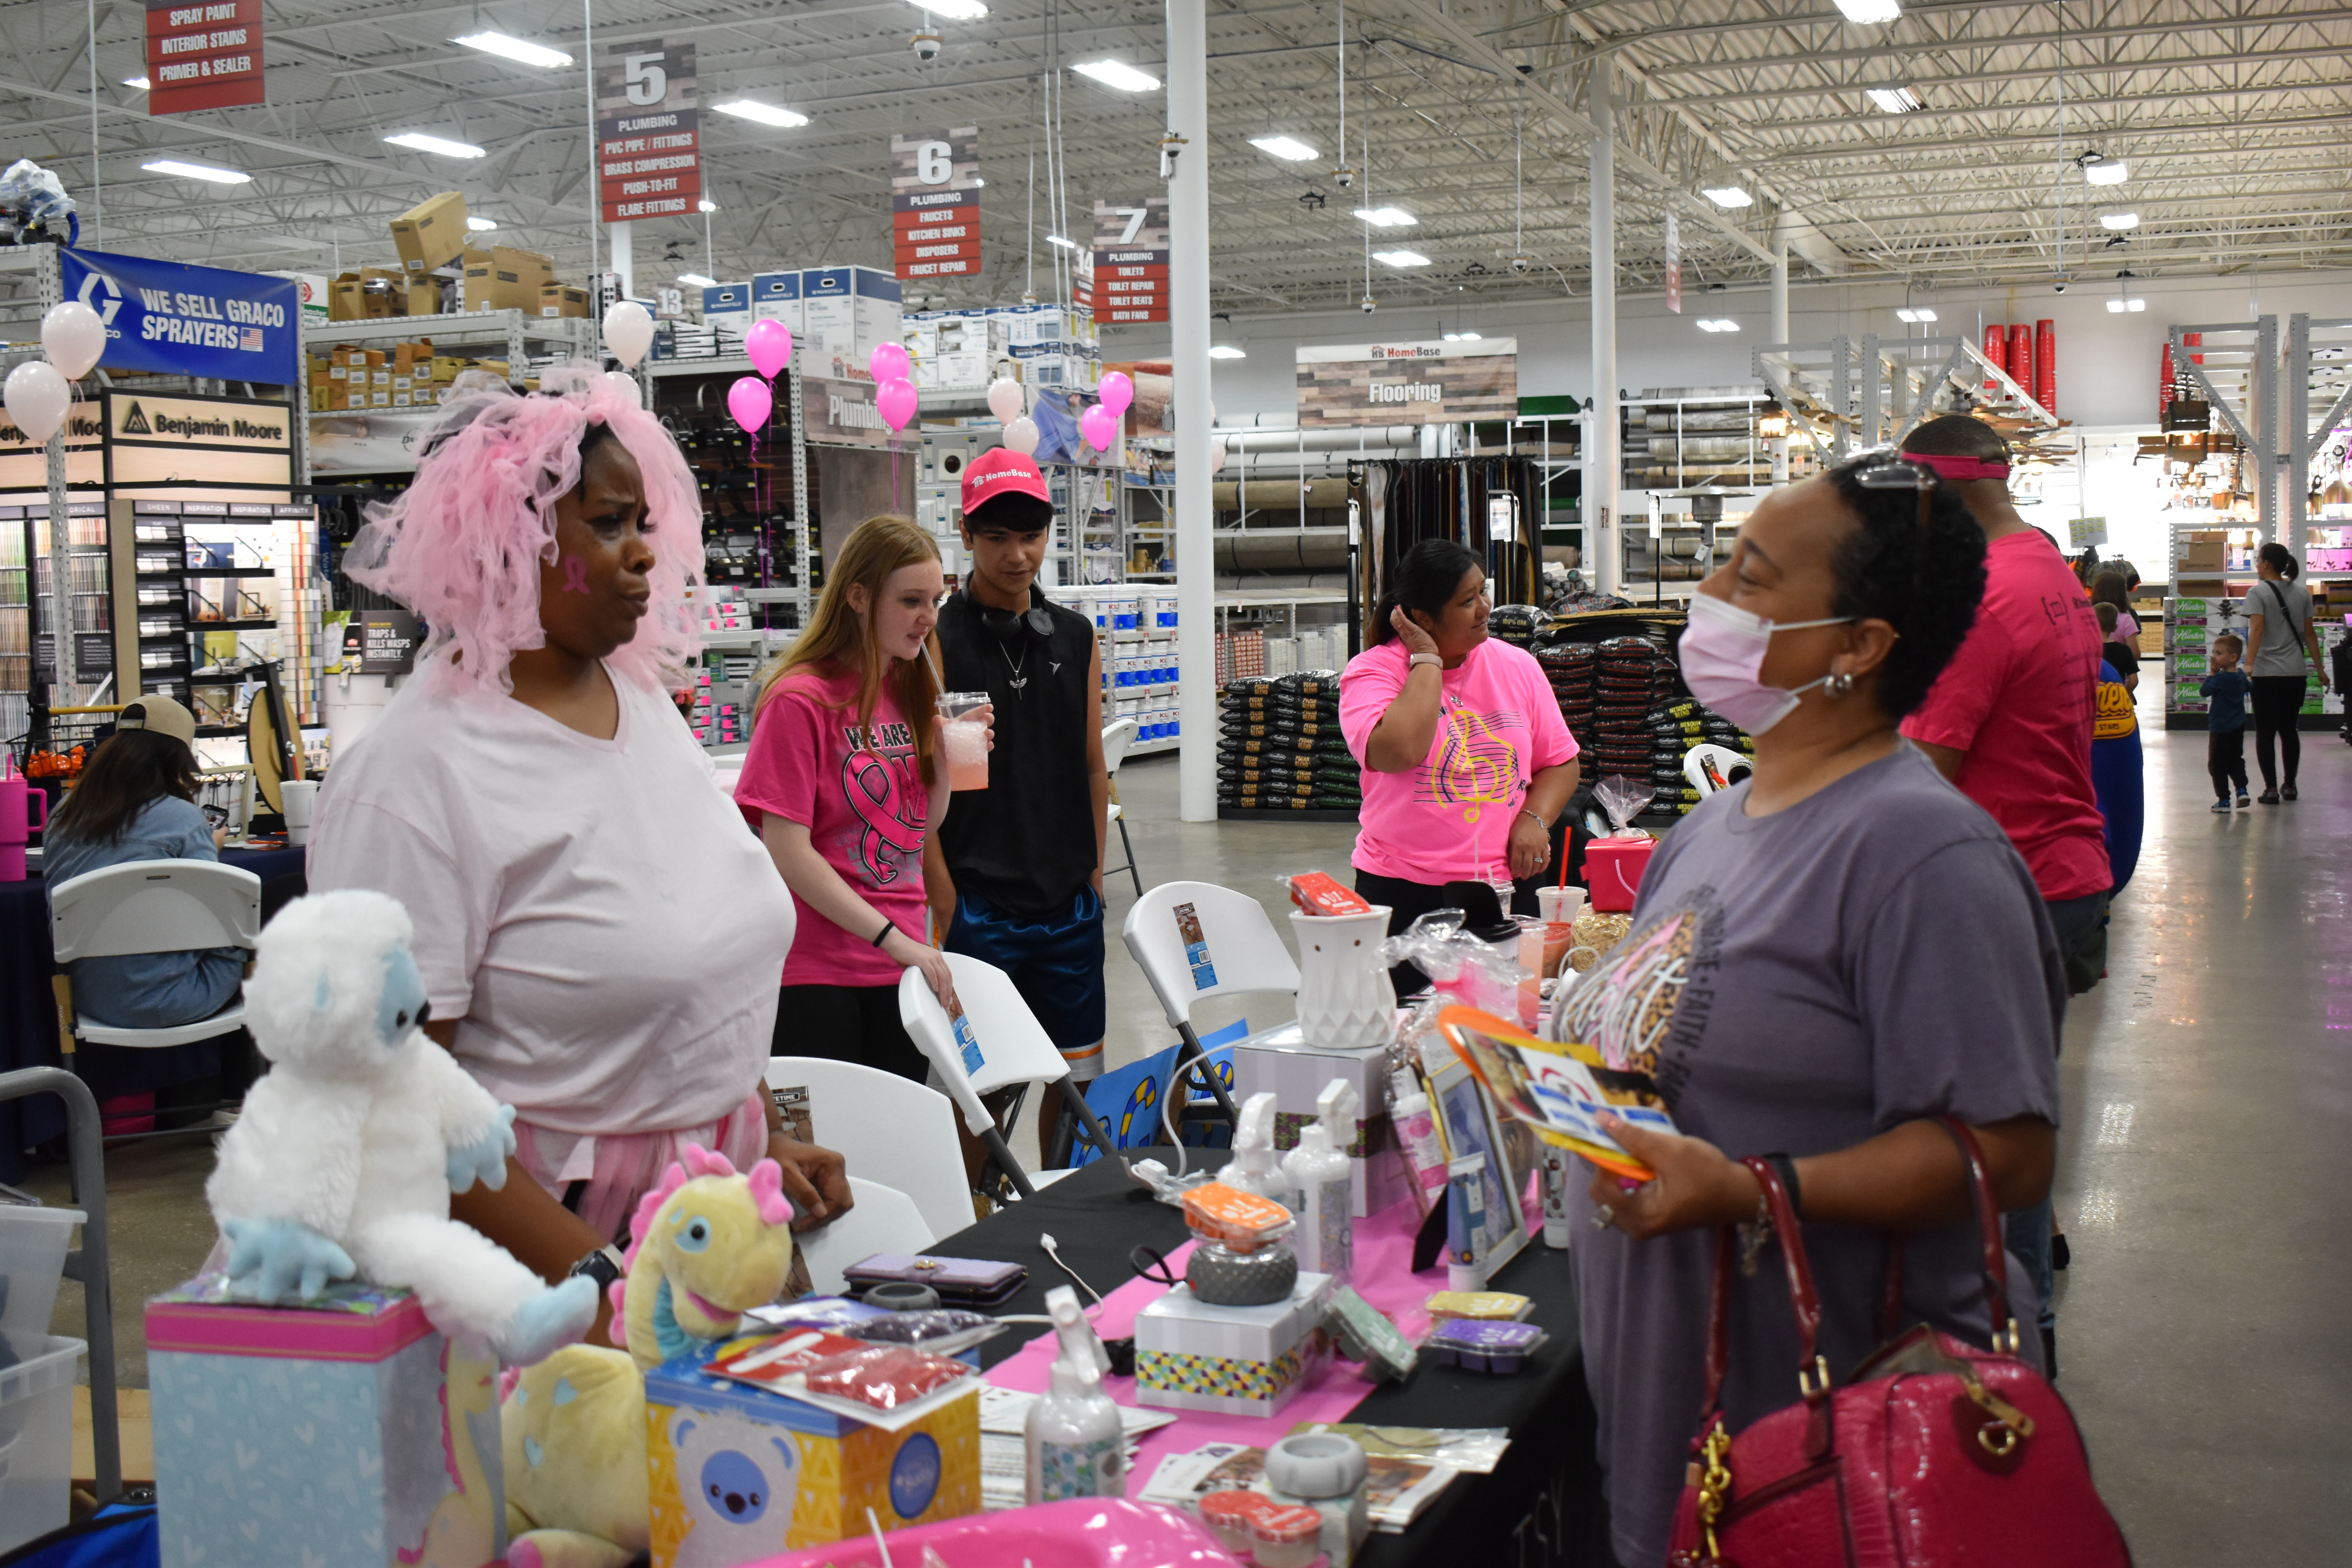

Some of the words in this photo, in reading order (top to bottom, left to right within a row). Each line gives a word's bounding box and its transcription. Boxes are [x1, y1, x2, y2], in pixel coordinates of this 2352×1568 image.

[170, 8, 203, 26] SPRAY
[206, 3, 236, 21] PAINT
[162, 34, 208, 54] INTERIOR
[210, 29, 247, 48] STAINS
[160, 62, 199, 82] PRIMER
[201, 61, 211, 76] &
[213, 56, 251, 75] SEALER
[626, 52, 666, 105] 5
[619, 115, 678, 132] PLUMBING
[605, 141, 623, 154] PVC
[625, 139, 645, 153] PIPE
[653, 133, 692, 149] FITTINGS
[604, 162, 633, 176] BRASS
[635, 155, 696, 172] COMPRESSION
[918, 141, 953, 185] 6
[623, 178, 678, 194] PUSH-TO-FIT
[617, 204, 644, 216] FLARE
[646, 198, 686, 214] FITTINGS
[911, 192, 962, 206] PLUMBING
[919, 210, 953, 223] FAUCETS
[908, 229, 941, 241] KITCHEN
[942, 227, 966, 238] SINKS
[1116, 208, 1147, 244] 7
[916, 244, 959, 258] DISPOSERS
[1109, 252, 1154, 261] PLUMBING
[909, 264, 938, 275] FAUCET
[940, 261, 967, 273] REPAIR
[1077, 248, 1094, 279] 14
[1118, 267, 1145, 276] TOILETS
[1108, 282, 1130, 291] TOILET
[1131, 281, 1154, 291] REPAIR
[139, 287, 174, 313] WE
[176, 293, 223, 320] SELL
[226, 299, 285, 328] GRACO
[658, 289, 683, 315] 13
[1109, 297, 1131, 306] TOILET
[1132, 296, 1153, 305] SEATS
[1112, 312, 1131, 320] BATH
[1132, 311, 1149, 320] FANS
[141, 315, 239, 349] SPRAYERS
[1387, 347, 1441, 358] HomeBase
[847, 363, 873, 381] Home
[1370, 381, 1441, 403] Flooring
[829, 395, 893, 436] Plumbi
[156, 414, 230, 436] Benjamin
[234, 419, 282, 440] Moore
[985, 469, 1031, 481] HomeBase
[2177, 601, 2205, 612] Hunter
[368, 629, 390, 638] TRAPS
[390, 629, 396, 638] &
[2176, 630, 2205, 640] Hunter
[367, 639, 386, 648] KILLS
[386, 639, 411, 648] WASPS
[2177, 659, 2205, 669] Hunter
[2176, 686, 2200, 697] Hunte
[1669, 703, 1693, 714] MESQUITE
[1675, 710, 1690, 718] BLEND
[844, 726, 881, 751] WE
[880, 722, 913, 748] ARE
[1673, 989, 1715, 1049] FAITH
